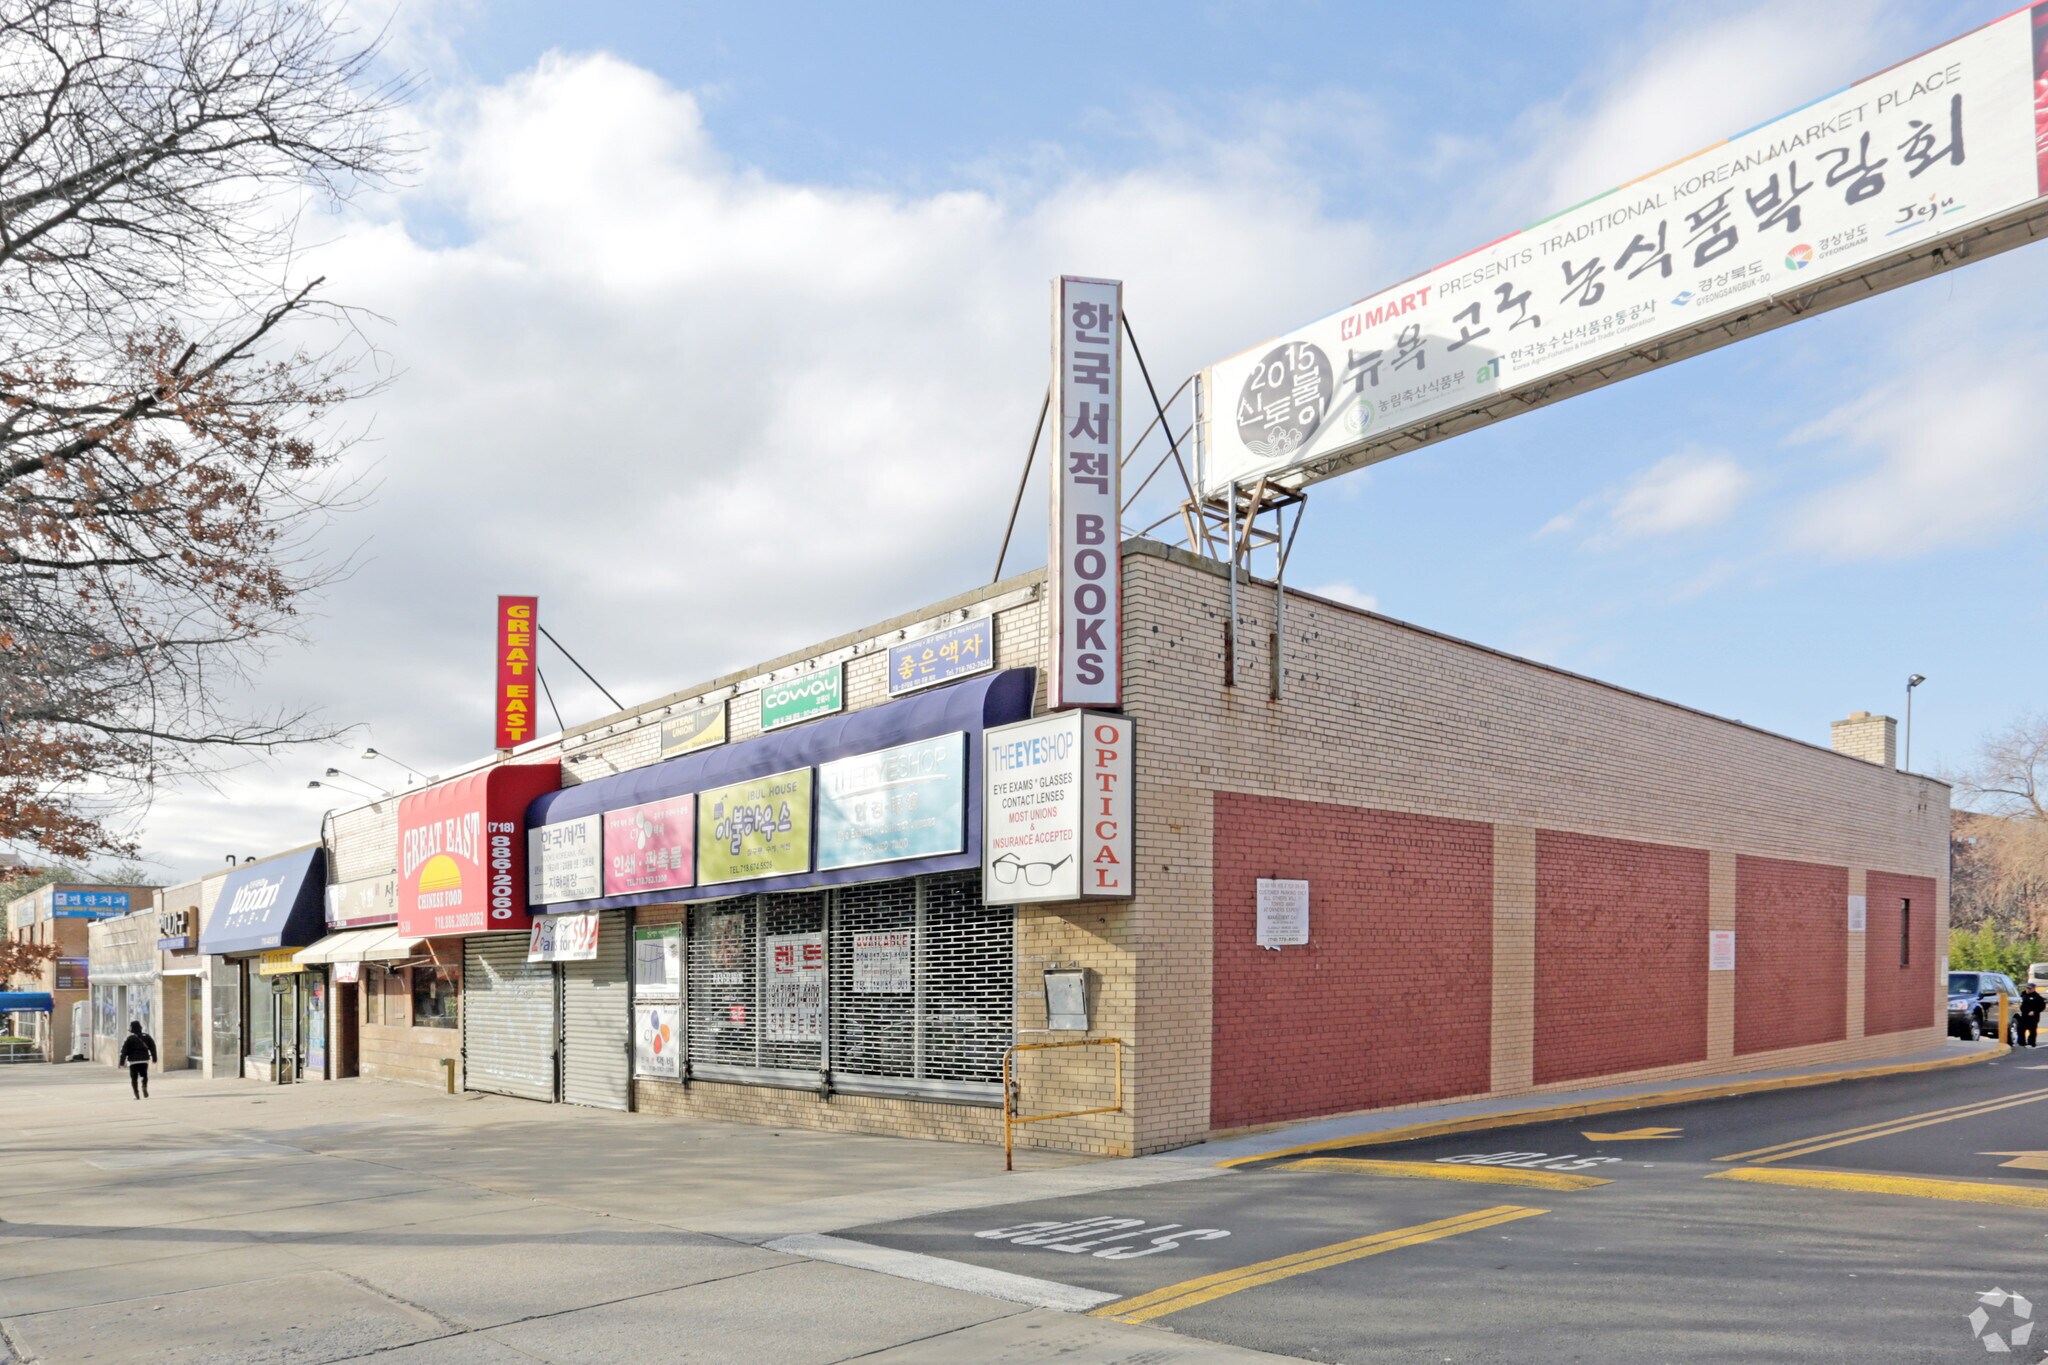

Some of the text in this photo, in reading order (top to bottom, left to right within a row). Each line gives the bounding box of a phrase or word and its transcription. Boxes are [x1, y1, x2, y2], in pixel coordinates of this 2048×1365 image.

[1365, 286, 1431, 329] MART
[1439, 248, 1533, 299] PRESENTS
[1539, 193, 1667, 256] TRADITIONAL
[1673, 150, 1762, 201] KOREAN
[1768, 103, 1869, 160] MARKET
[1878, 62, 1962, 114] PLACE
[1895, 194, 1954, 223] Jeju
[1818, 223, 1868, 251] 경상남도
[1699, 259, 1764, 292] 경상북도
[1343, 323, 1428, 393] 뉴욕
[1446, 281, 1541, 352] 고국
[1251, 343, 1315, 391] 2015
[1068, 301, 1113, 494] 한국서적
[1378, 370, 1466, 412] 농림축산식품부
[1073, 513, 1107, 685] BOOKS
[506, 605, 531, 675] GREAT
[897, 633, 984, 681] 좋은액자
[766, 675, 838, 709] coway
[505, 684, 529, 741] EAST
[662, 714, 694, 732] WESTERN
[672, 723, 694, 738] UNION
[747, 781, 798, 801] IBUL HOUSE
[994, 772, 1073, 795] EYE EXAMS GLASSES
[1002, 789, 1065, 809] CONTACT LENSES
[1008, 806, 1058, 824] MOST UNIONS
[1093, 725, 1120, 887] OPTICAL
[488, 821, 515, 833] (718)
[541, 822, 587, 852] 한국서적
[715, 800, 793, 857] 이불하우스
[993, 829, 1073, 849] INSURANCE ACCEPTED
[1030, 822, 1035, 831] &
[403, 811, 481, 880] GREAT EAST
[491, 835, 513, 920] 886-2060
[613, 853, 636, 878] 인쇄
[645, 846, 683, 874] 판촉물
[418, 889, 463, 910] CHINESE FOOD
[531, 921, 542, 953] 2
[560, 935, 571, 951] for
[856, 934, 908, 948] AVAILABLE
